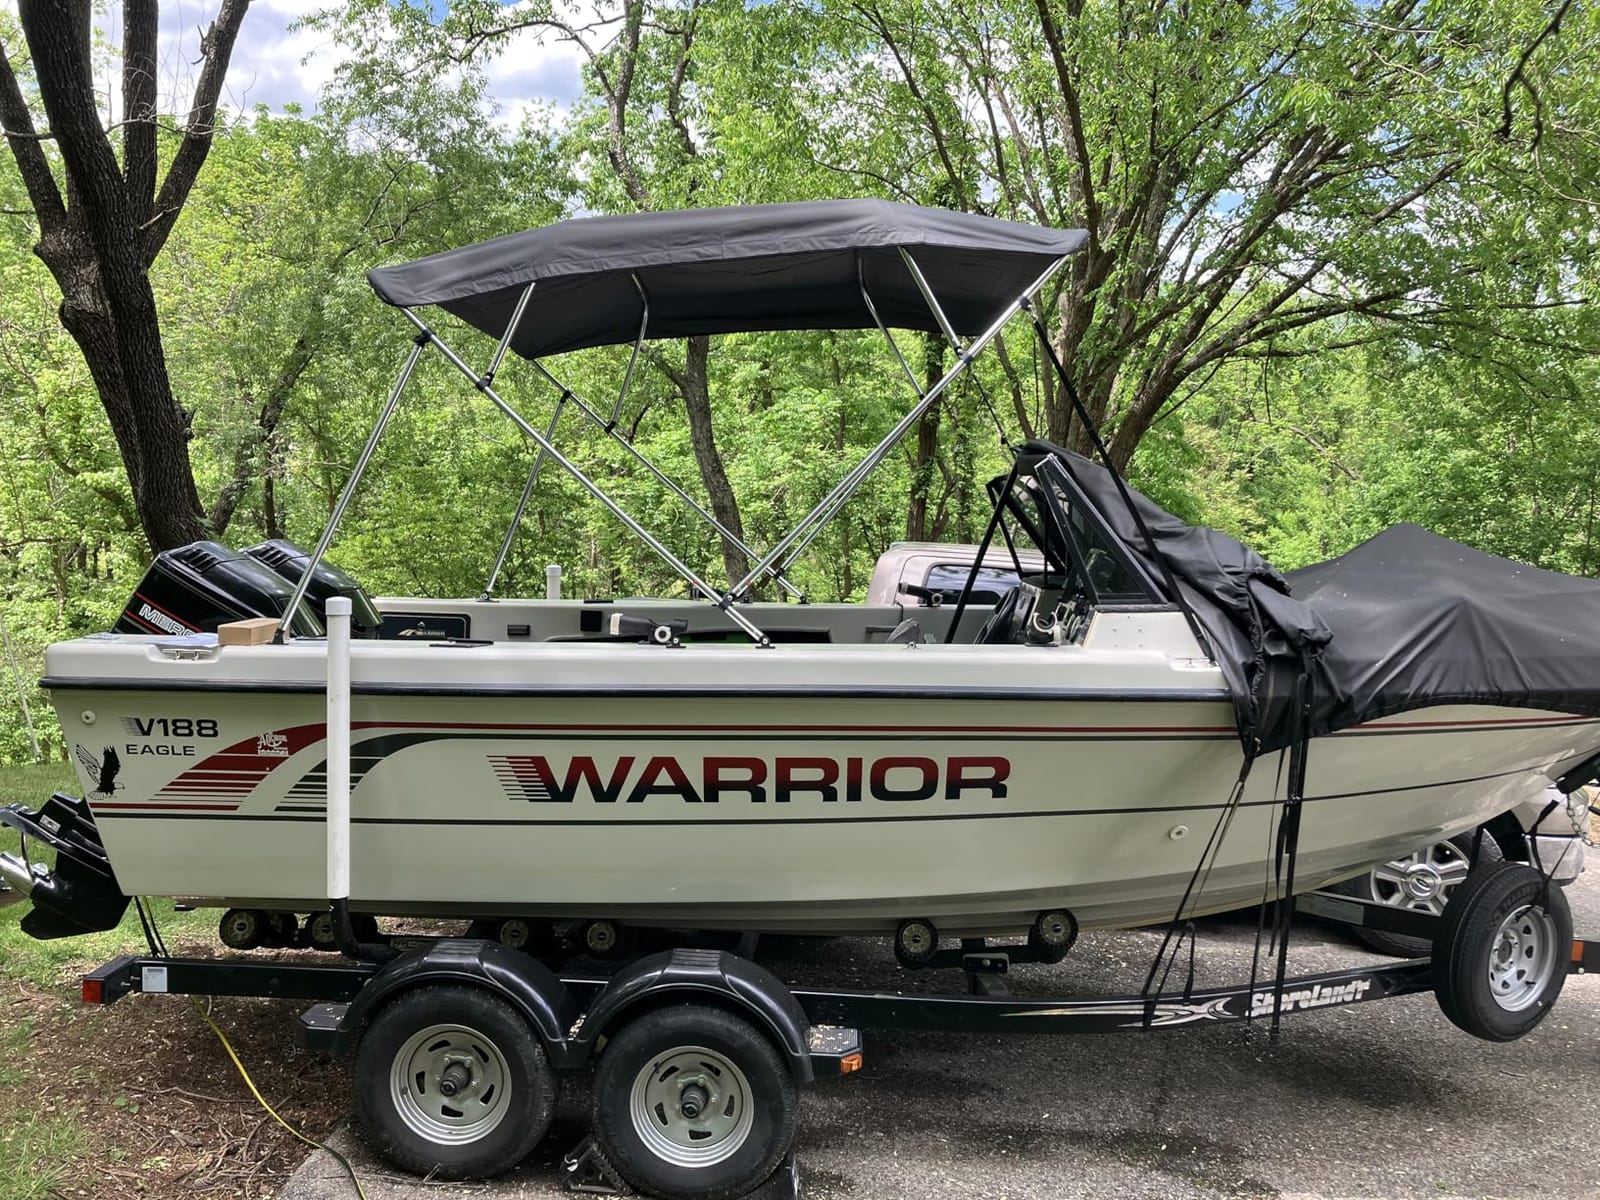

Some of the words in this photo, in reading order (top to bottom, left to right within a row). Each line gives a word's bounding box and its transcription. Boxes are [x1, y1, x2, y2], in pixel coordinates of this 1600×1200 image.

[132, 717, 219, 737] V188
[125, 743, 196, 757] EAGLE
[487, 755, 1012, 803] WARRIOR
